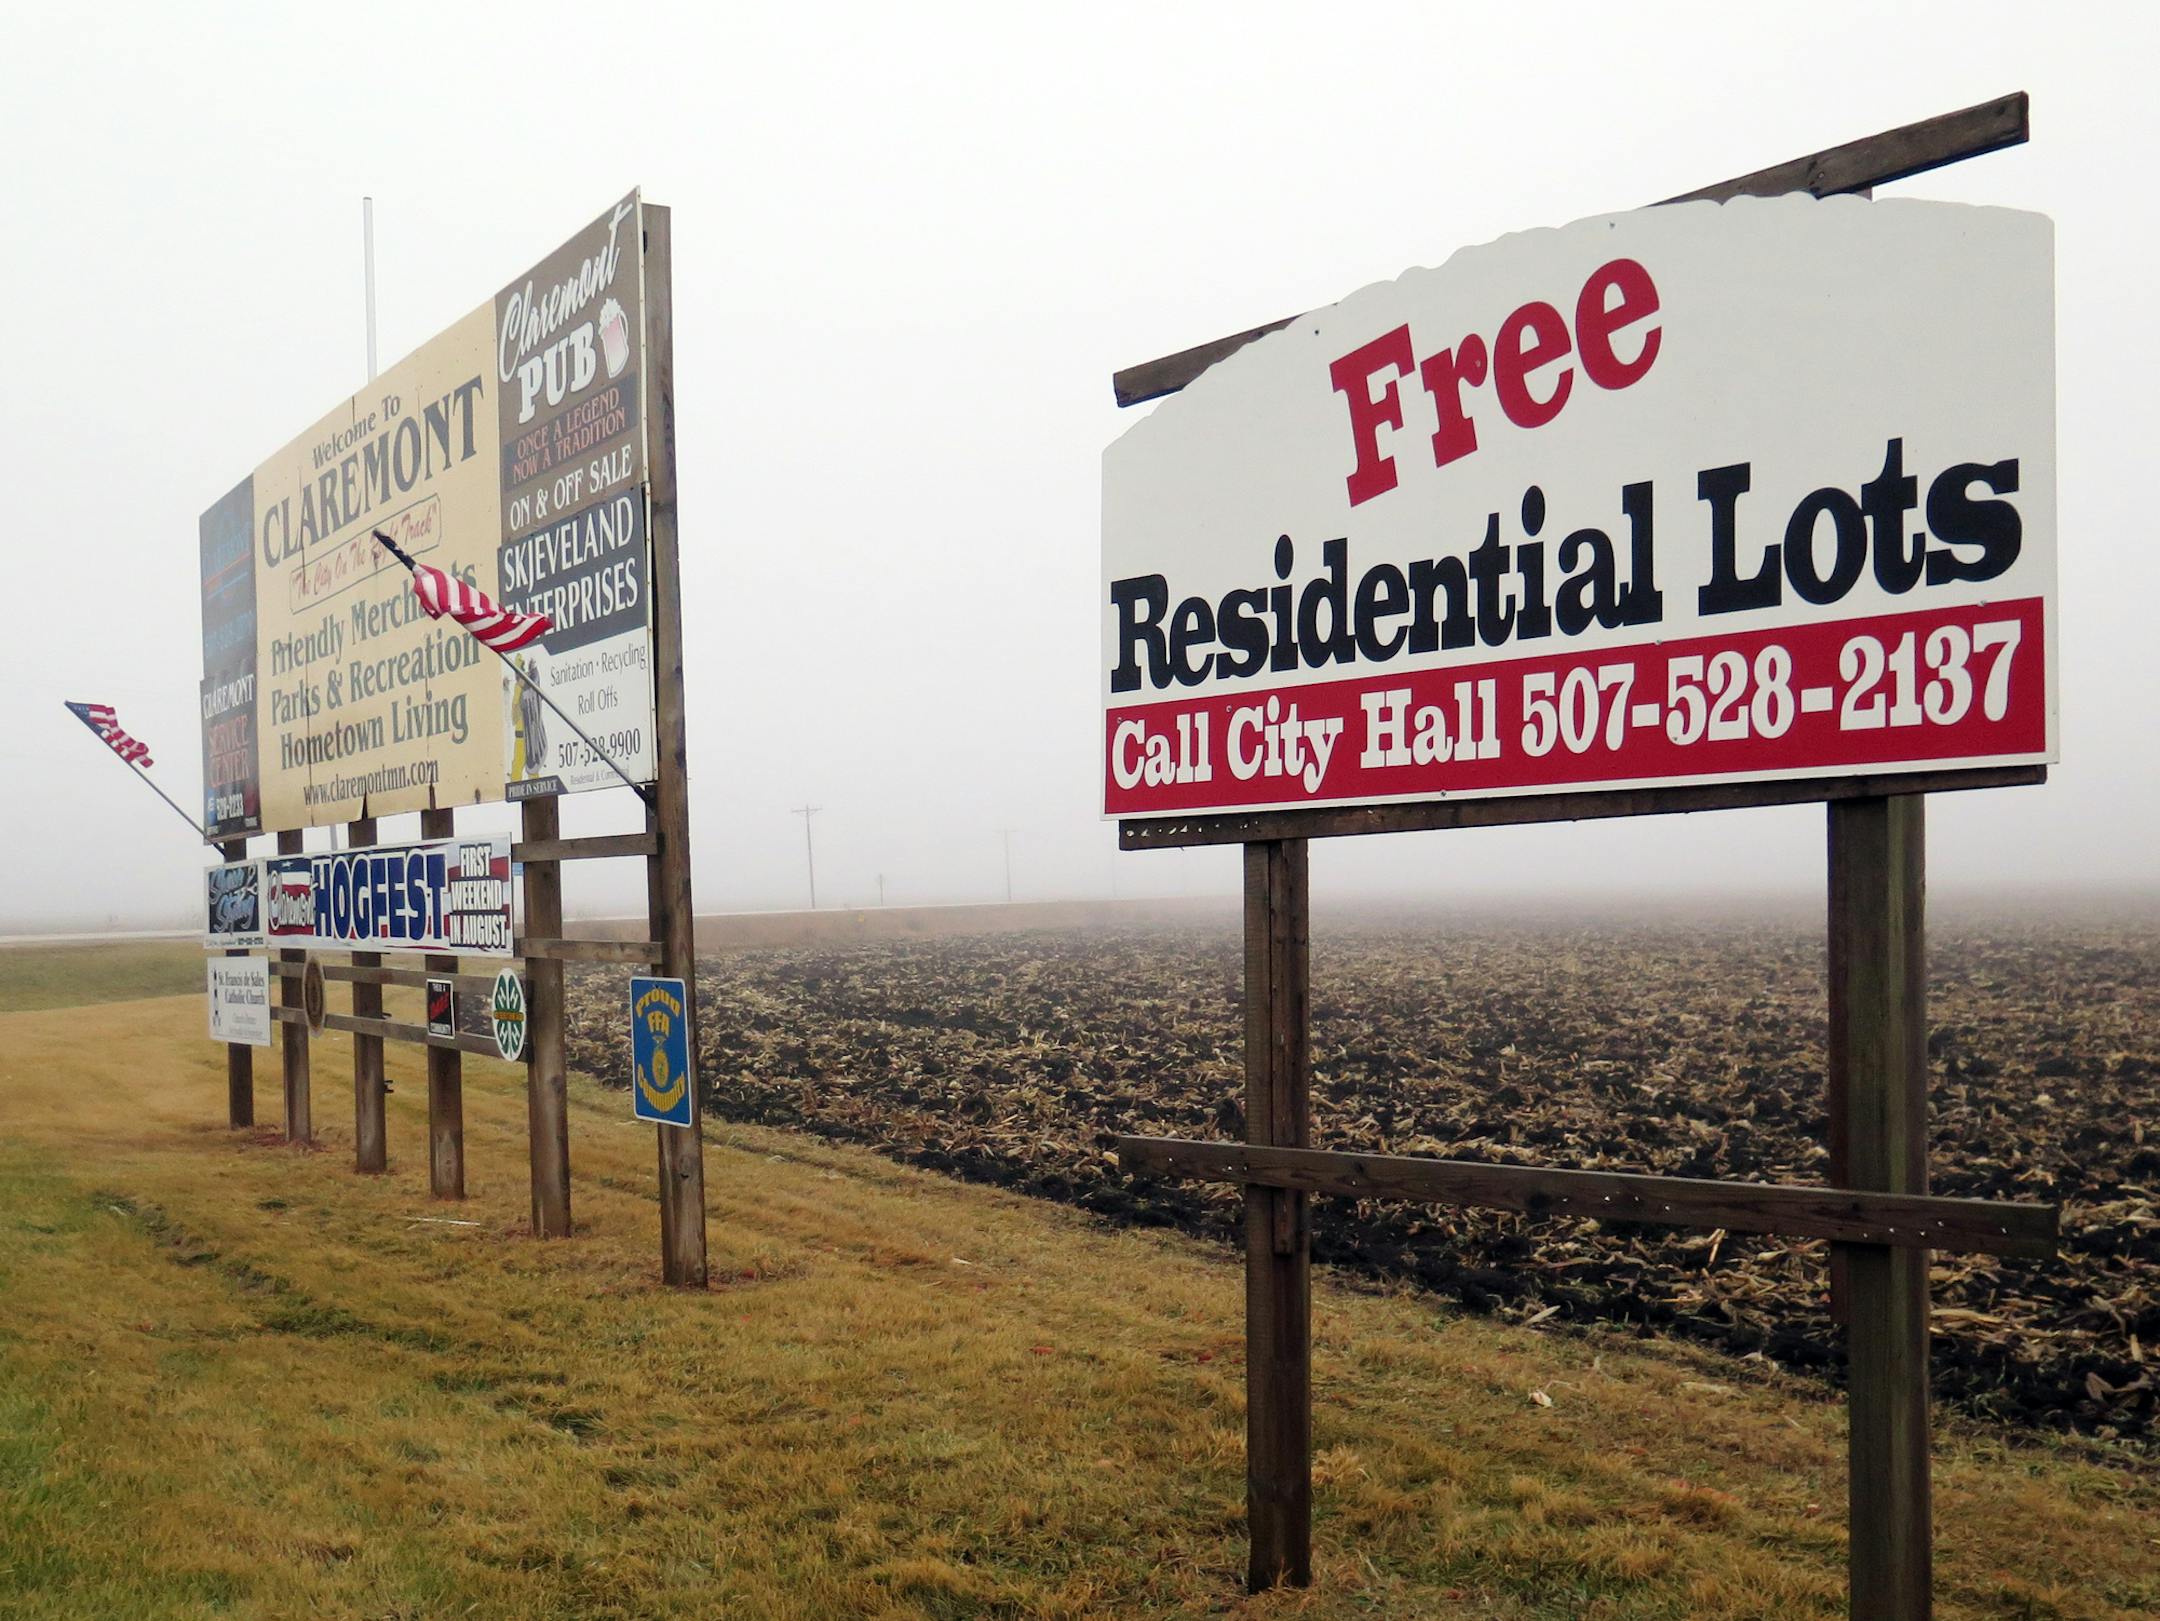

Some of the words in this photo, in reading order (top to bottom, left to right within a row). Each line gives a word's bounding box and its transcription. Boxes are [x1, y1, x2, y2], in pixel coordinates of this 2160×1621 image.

[500, 203, 633, 383] Claremont
[517, 321, 596, 425] PUB
[1329, 258, 1662, 507] Free
[312, 412, 376, 469] Welcome
[381, 395, 401, 422] To
[512, 453, 538, 485] NOW
[543, 448, 552, 470] A
[555, 406, 625, 461] TRADITION
[517, 425, 549, 459] ONCE
[553, 419, 562, 442] A
[566, 387, 620, 432] LEGEND
[263, 374, 484, 568] CLAREMONT
[510, 495, 530, 531] ON
[535, 488, 549, 519] &
[554, 468, 584, 511] OFF
[589, 443, 632, 494] SALE
[504, 496, 634, 593] SKJEVELAND
[1110, 480, 1664, 694] Residential
[1697, 437, 2024, 616] Lots
[270, 613, 344, 677] Friendly
[272, 679, 321, 726] Parks
[327, 669, 343, 710] &
[350, 628, 481, 704] Recreation
[550, 659, 594, 687] Sanitation
[601, 643, 647, 674] Recycling
[202, 674, 255, 719] CLAREMONT
[281, 714, 384, 771] Hometown
[392, 690, 469, 745] Living
[578, 691, 595, 715] Roll
[598, 685, 619, 710] Offs
[1111, 711, 1212, 790] Call
[1227, 695, 1343, 794] City
[1360, 678, 1500, 769] Hall
[1521, 619, 2022, 758] 507-528-2137
[209, 750, 249, 788] CENTER
[304, 759, 439, 806] www.claremontmn.com
[312, 849, 448, 941] HOGFEST
[451, 879, 503, 911] WEEKEND
[460, 845, 491, 877] FIRST
[450, 914, 461, 946] IN
[462, 914, 507, 947] AUGUST
[647, 1010, 670, 1038] FFA
